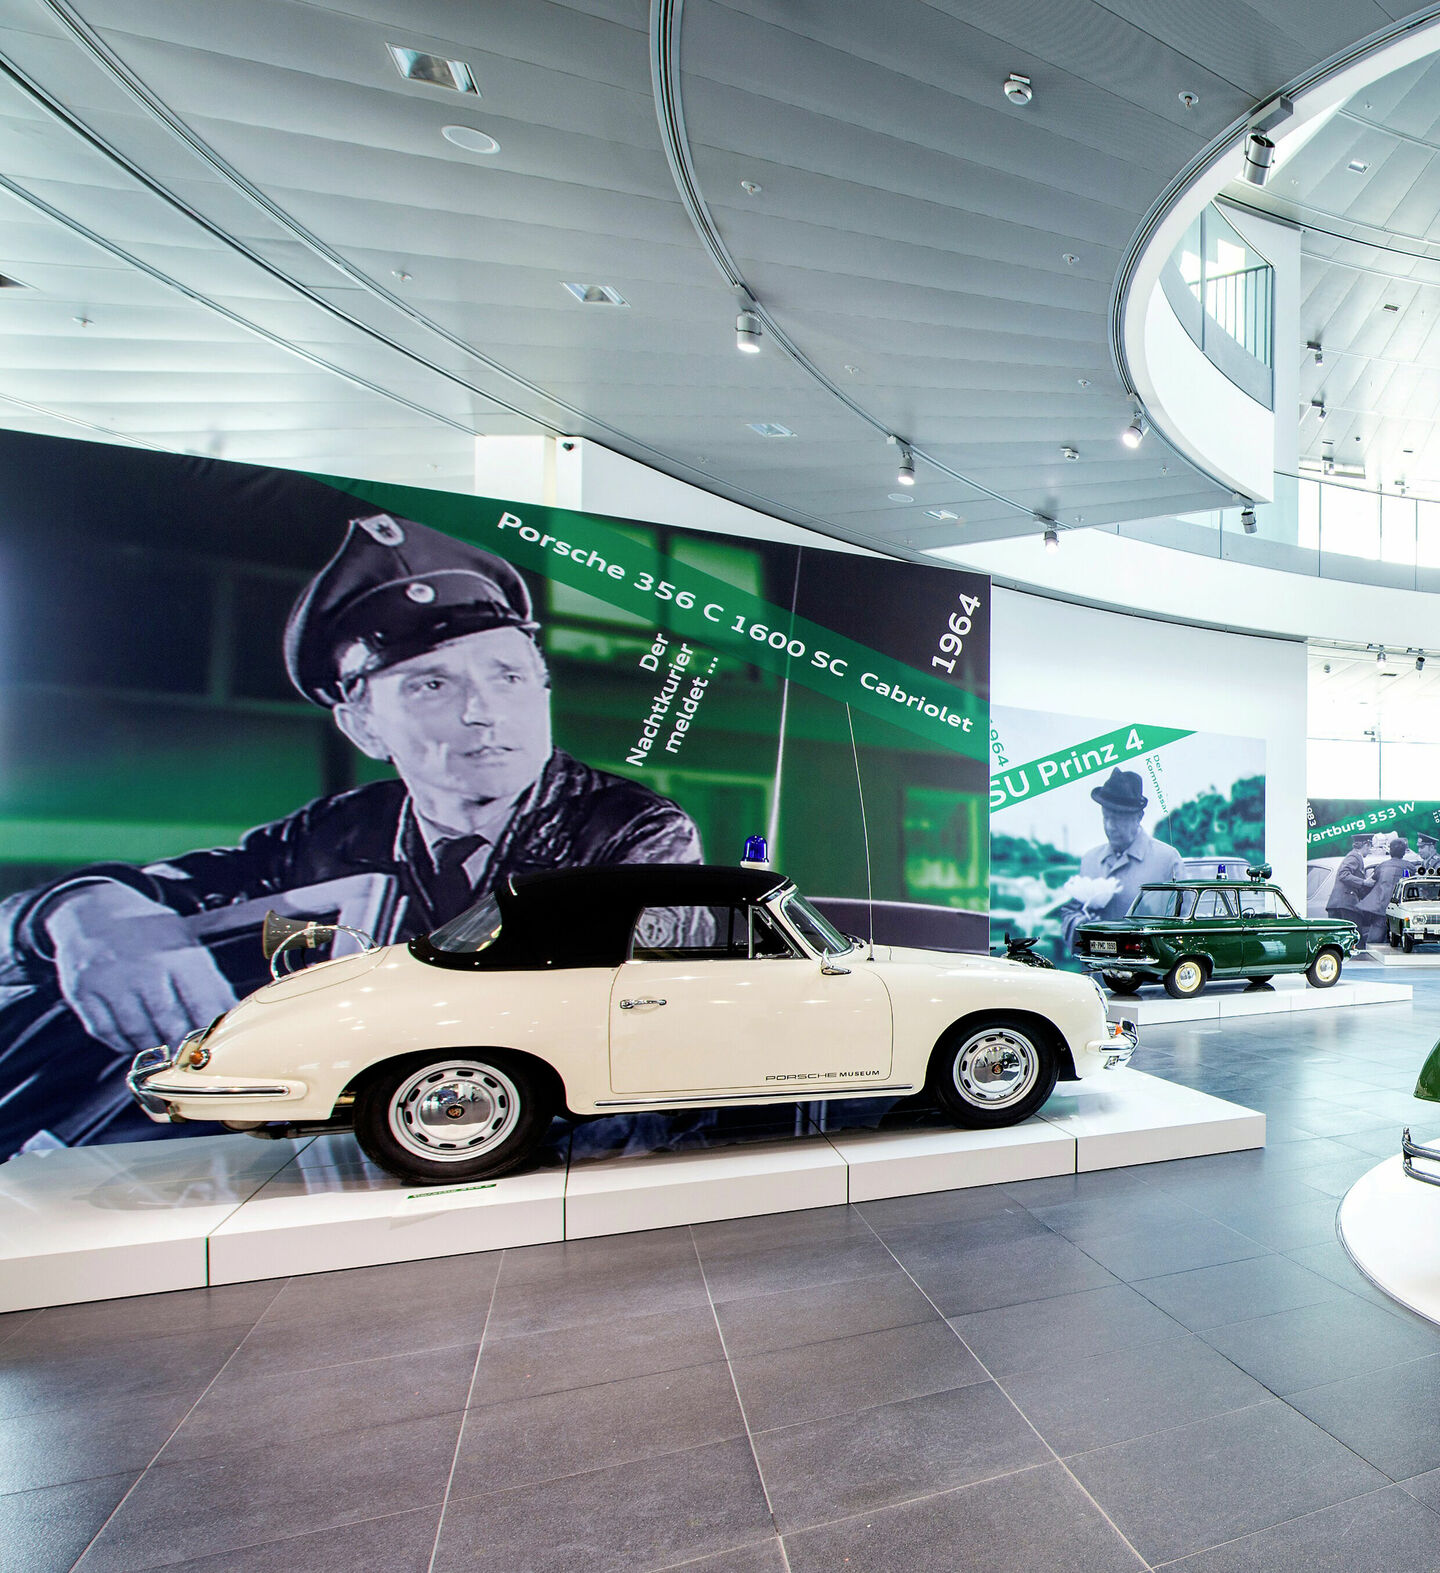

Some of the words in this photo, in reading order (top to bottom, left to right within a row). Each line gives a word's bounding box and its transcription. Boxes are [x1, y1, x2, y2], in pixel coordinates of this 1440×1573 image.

[497, 511, 626, 581] Porsche
[633, 571, 697, 610] 356
[703, 602, 725, 624] C
[730, 614, 806, 659] 1600
[811, 650, 849, 678] SC
[859, 672, 974, 735] Cabriolet
[931, 592, 981, 675] 1964
[639, 633, 669, 672] Der
[625, 643, 694, 767] Nachtkurier
[665, 677, 709, 754] meldet
[990, 719, 1010, 767] 964
[1037, 743, 1118, 787] Prinz
[1125, 728, 1144, 751] 4
[1153, 755, 1163, 772] Der
[1145, 757, 1168, 814] Kommissar
[1368, 807, 1397, 824] 353
[1398, 801, 1415, 814] W
[765, 1072, 837, 1081] PORSCHE
[839, 1070, 880, 1078] MUSEUM
